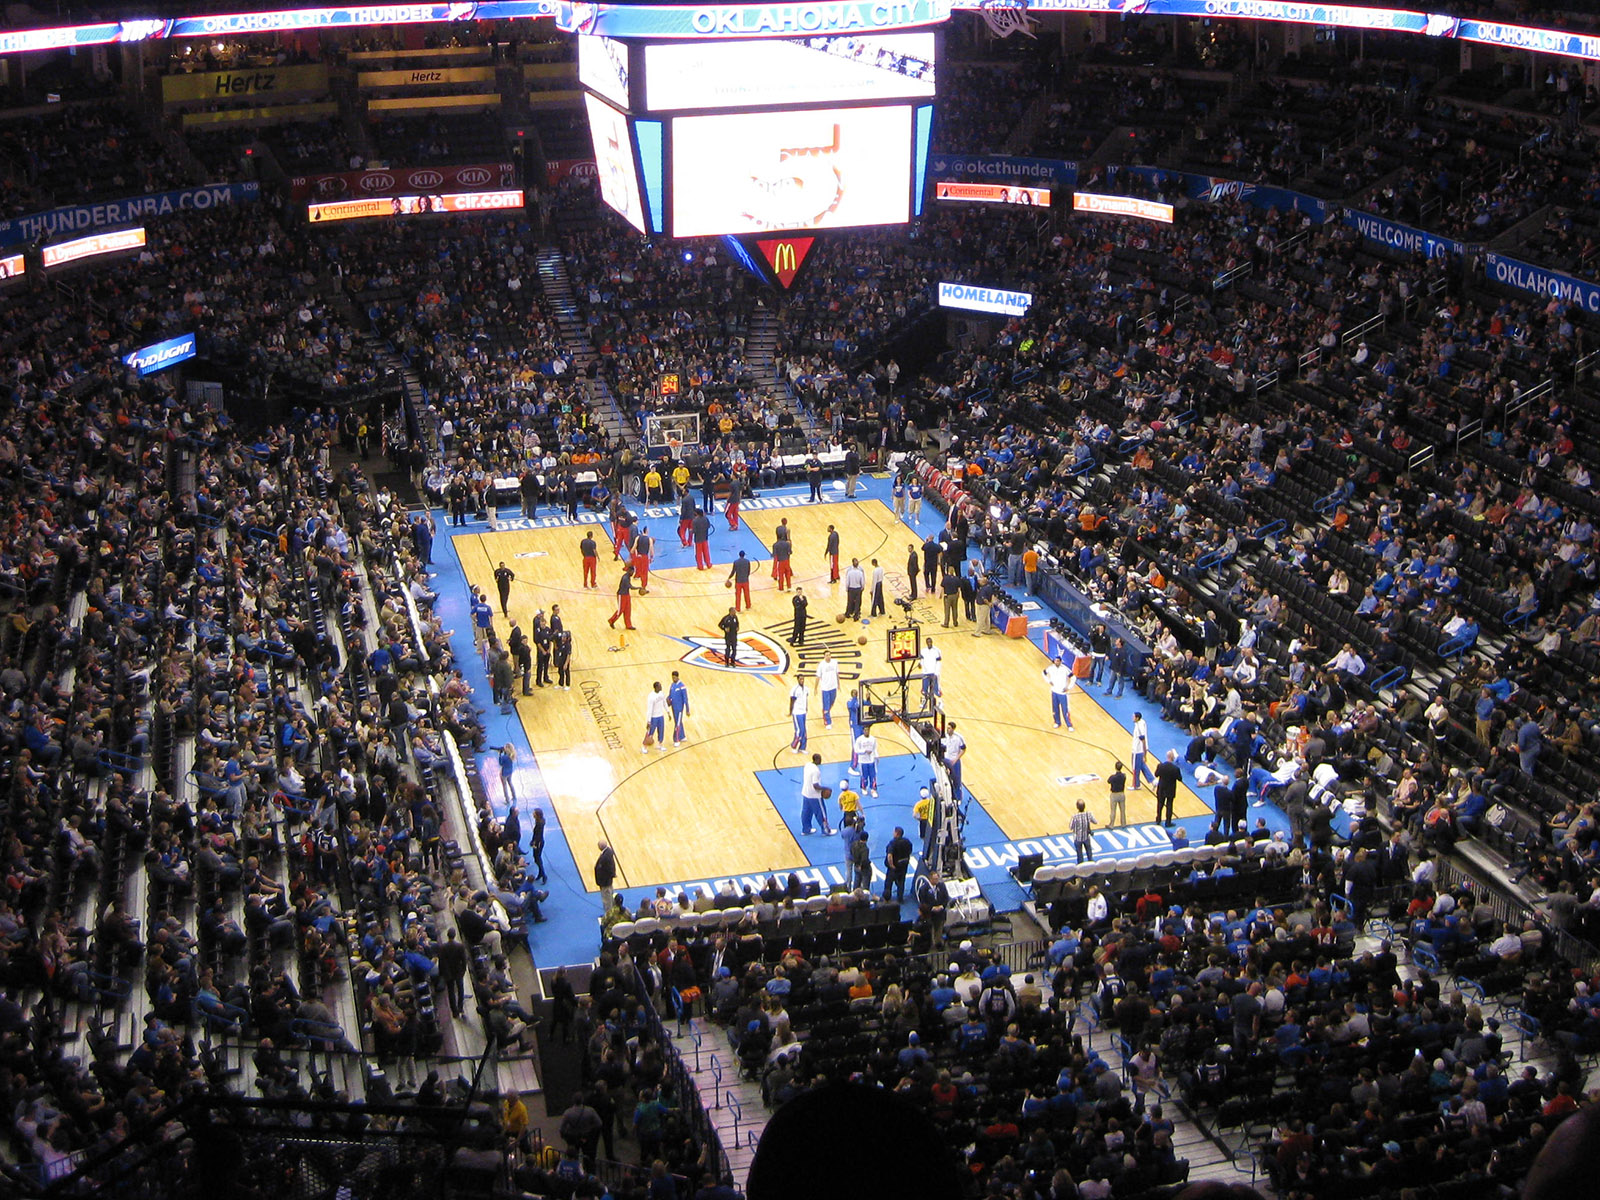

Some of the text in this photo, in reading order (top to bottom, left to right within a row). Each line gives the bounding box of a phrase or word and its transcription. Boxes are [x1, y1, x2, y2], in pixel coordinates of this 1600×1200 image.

[203, 7, 433, 32] OKLAHOMA CITY THUNDER
[692, 4, 863, 33] OKLAHOMA
[870, 1, 917, 26] CITY
[1204, 1, 1393, 27] OKLAHOMA CITY THUNDER
[1478, 23, 1541, 47] OKLAHOMA
[1545, 34, 1571, 51] CITY
[216, 74, 275, 93] Hertz
[412, 72, 441, 82] Hertz
[952, 160, 1054, 178] @okcthunder
[1064, 162, 1076, 170] 112
[292, 178, 306, 186] 110
[365, 178, 389, 188] KIA
[414, 175, 436, 185] KIA
[462, 171, 485, 181] KIA
[950, 186, 993, 196] Continental
[1209, 181, 1237, 201] OKC
[323, 202, 380, 216] Continental
[455, 194, 520, 209] clr.com
[1079, 197, 1087, 207] A
[1090, 198, 1136, 212] Dynamic
[1358, 217, 1445, 258] WELCOME TO
[47, 250, 55, 262] A
[56, 240, 98, 260] Dynamic
[1496, 262, 1584, 307] OKLAHOMA
[942, 285, 1028, 307] HOMELAND
[158, 341, 193, 362] LIGHT
[663, 382, 676, 393] 24
[894, 640, 915, 657] 24
